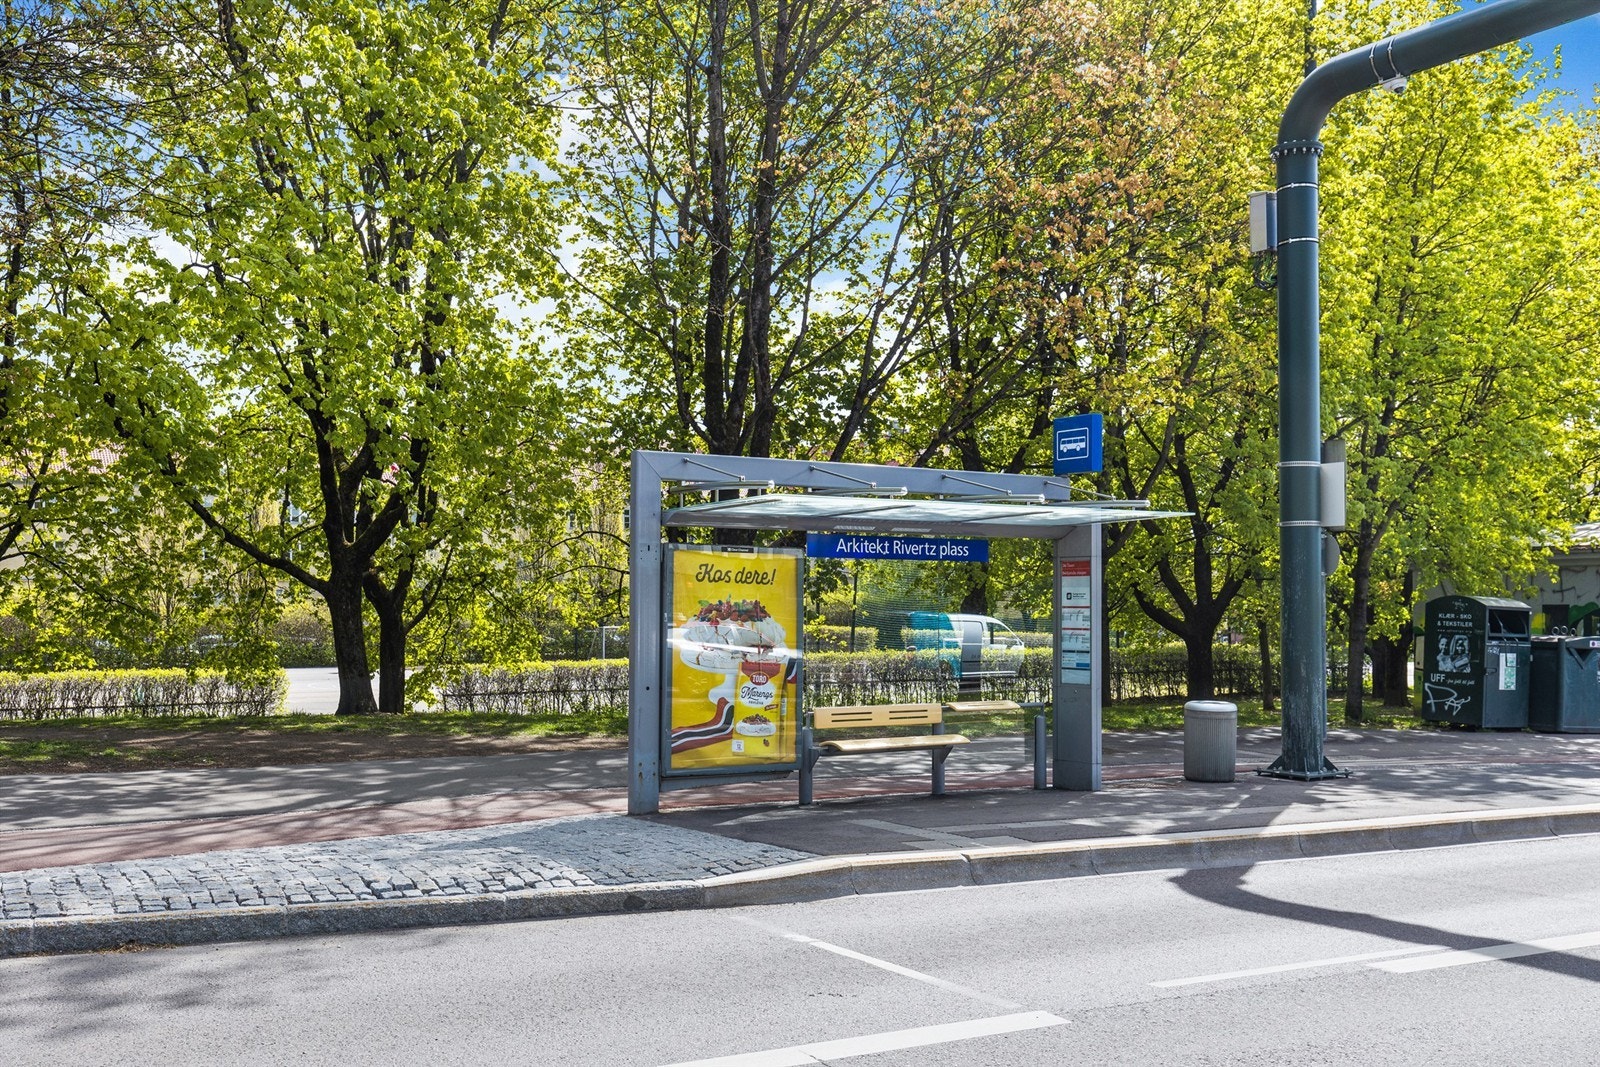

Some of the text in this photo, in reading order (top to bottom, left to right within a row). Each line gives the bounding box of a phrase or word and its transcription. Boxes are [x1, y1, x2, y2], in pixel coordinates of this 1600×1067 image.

[836, 538, 969, 559] Arkitekt Rivertz plass
[695, 563, 777, 585] Kos dere!
[1430, 673, 1446, 682] UFF
